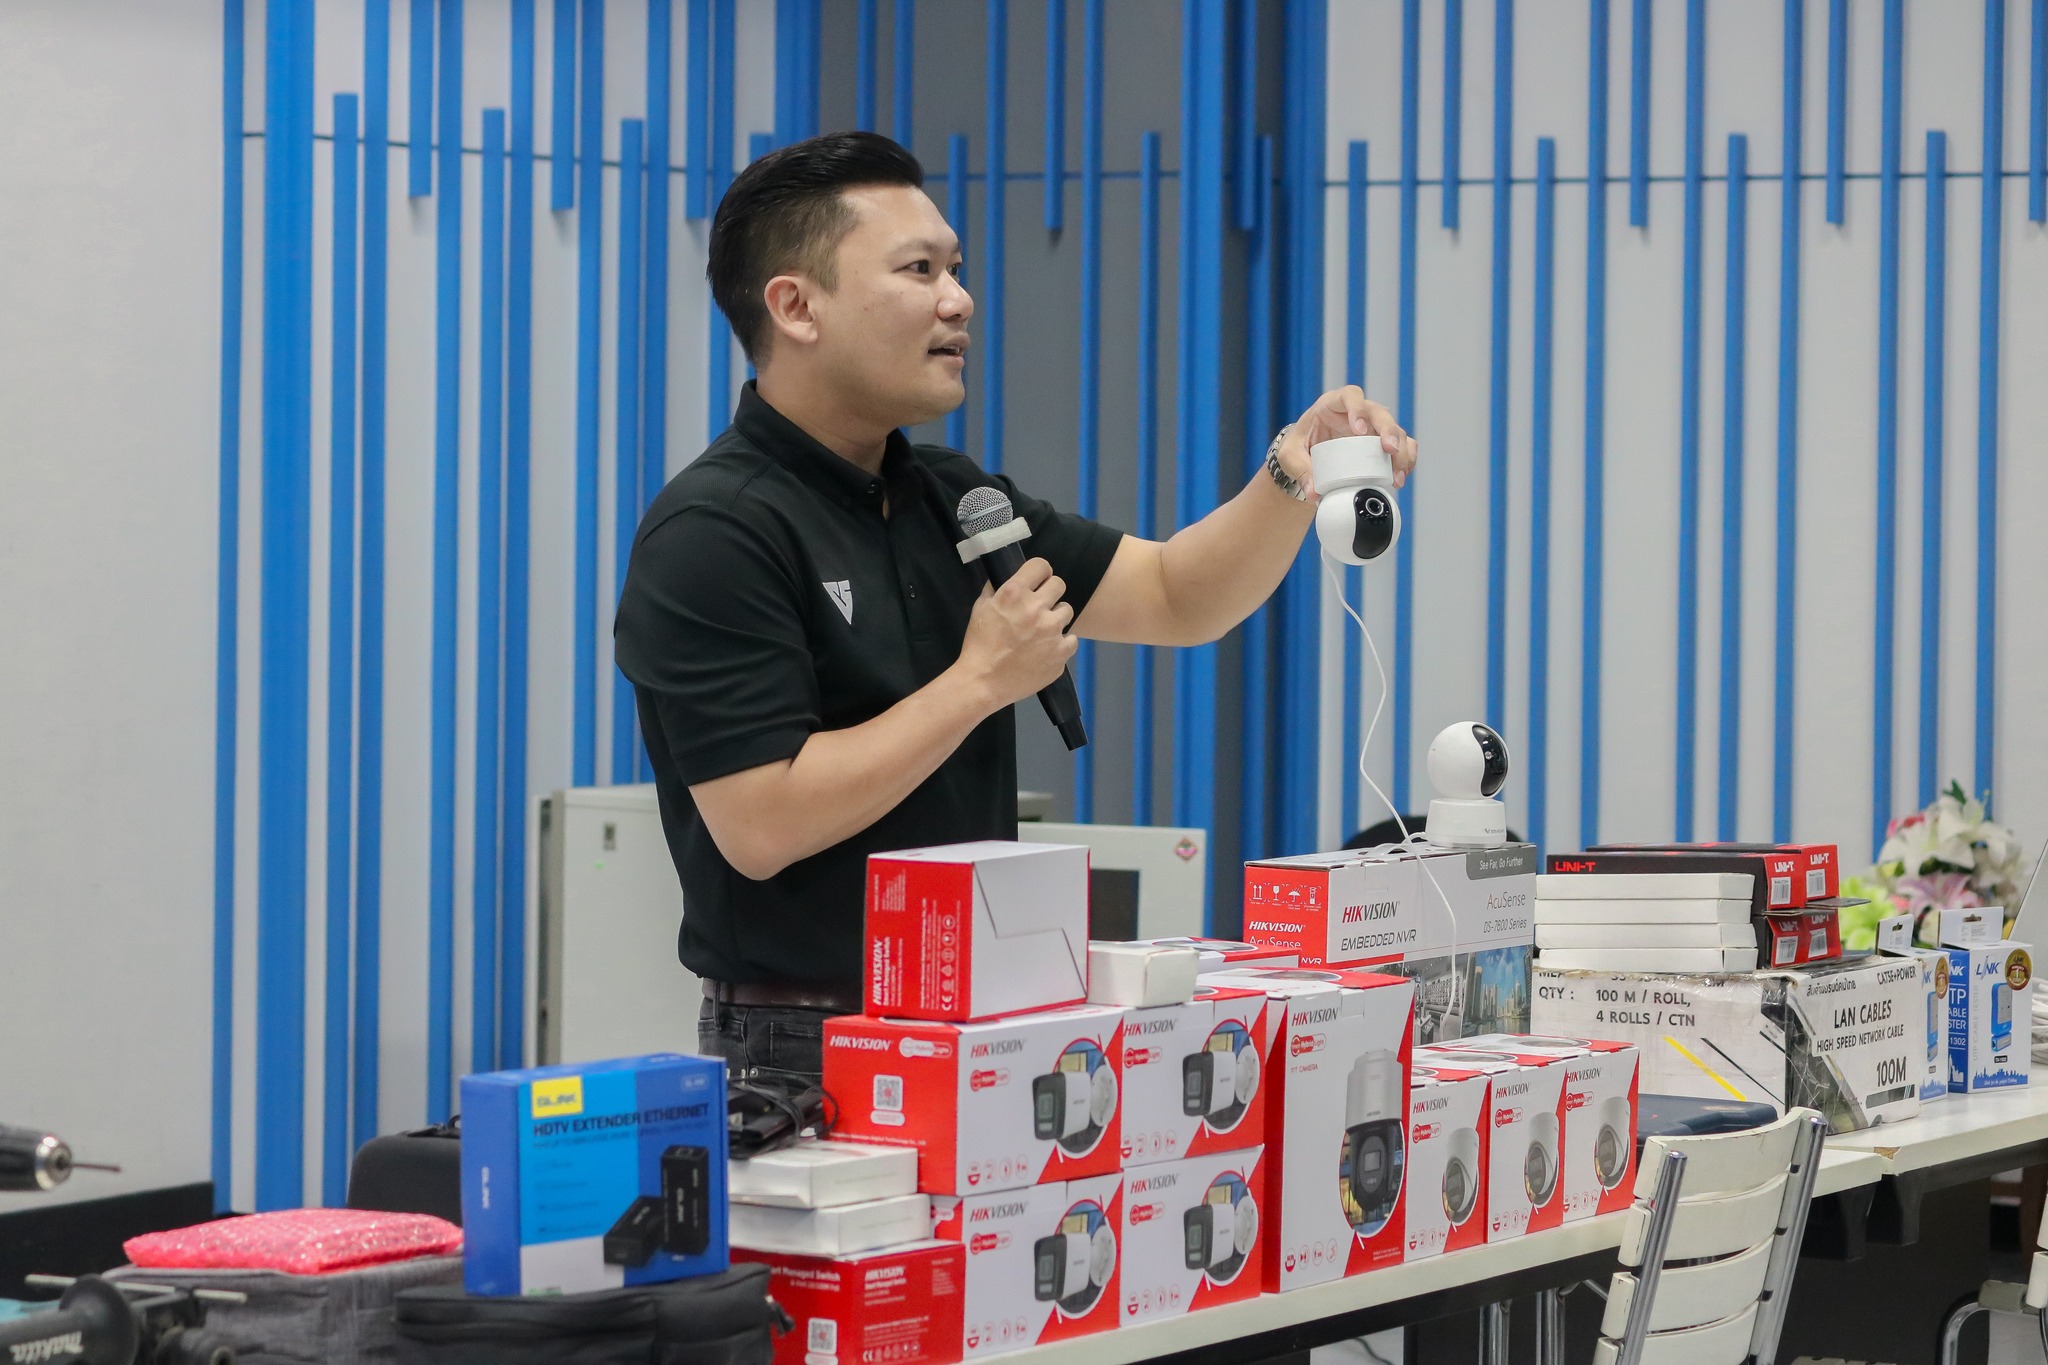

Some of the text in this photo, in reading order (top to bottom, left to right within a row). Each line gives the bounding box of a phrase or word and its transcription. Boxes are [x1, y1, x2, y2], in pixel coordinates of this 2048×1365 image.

[1480, 857, 1523, 870] See Far, Go Further
[1555, 861, 1596, 872] UNI-T
[1774, 861, 1795, 873] UNI-T
[1810, 853, 1829, 865] UNI-T
[1487, 891, 1526, 910] AcuSense
[1342, 901, 1398, 923] HIKVISION
[1249, 921, 1303, 932] HIKVISION
[1509, 918, 1527, 931] Series
[1341, 929, 1416, 951] EMBEDDED NVR
[1301, 957, 1322, 965] NVR
[873, 939, 883, 1005] HIKVISION
[1538, 986, 1565, 1000] QTY
[1596, 989, 1618, 1002] 100
[1624, 991, 1636, 1003] M
[1641, 989, 1647, 1004] /
[1653, 992, 1691, 1007] ROLL,
[1949, 988, 1966, 1004] TP
[1292, 1007, 1338, 1026] HIKVISION
[1596, 1010, 1695, 1027] 4 ROLLS / CTN
[1834, 999, 1892, 1029] LAN CABLES
[1948, 1008, 1966, 1018] ABLE
[1124, 1019, 1175, 1037] HIKVISION
[1948, 1019, 1966, 1030] STER
[830, 1035, 891, 1052] HIKVISION
[1816, 1024, 1904, 1053] HIGH SPEED NETWORK CABLE
[1948, 1037, 1966, 1046] -1302
[971, 1039, 1024, 1058] HIKVISION
[1567, 1068, 1601, 1082] HIKVISION
[1876, 1056, 1907, 1087] 100M
[1496, 1083, 1529, 1099] HIKVISION
[1413, 1097, 1448, 1114] HIKVISION
[534, 1122, 570, 1137] HDTV
[573, 1112, 640, 1132] EXTENDER
[644, 1102, 710, 1121] ETHERNET
[1130, 1174, 1178, 1194] HIKVISION
[970, 1202, 1026, 1222] HIKVISION
